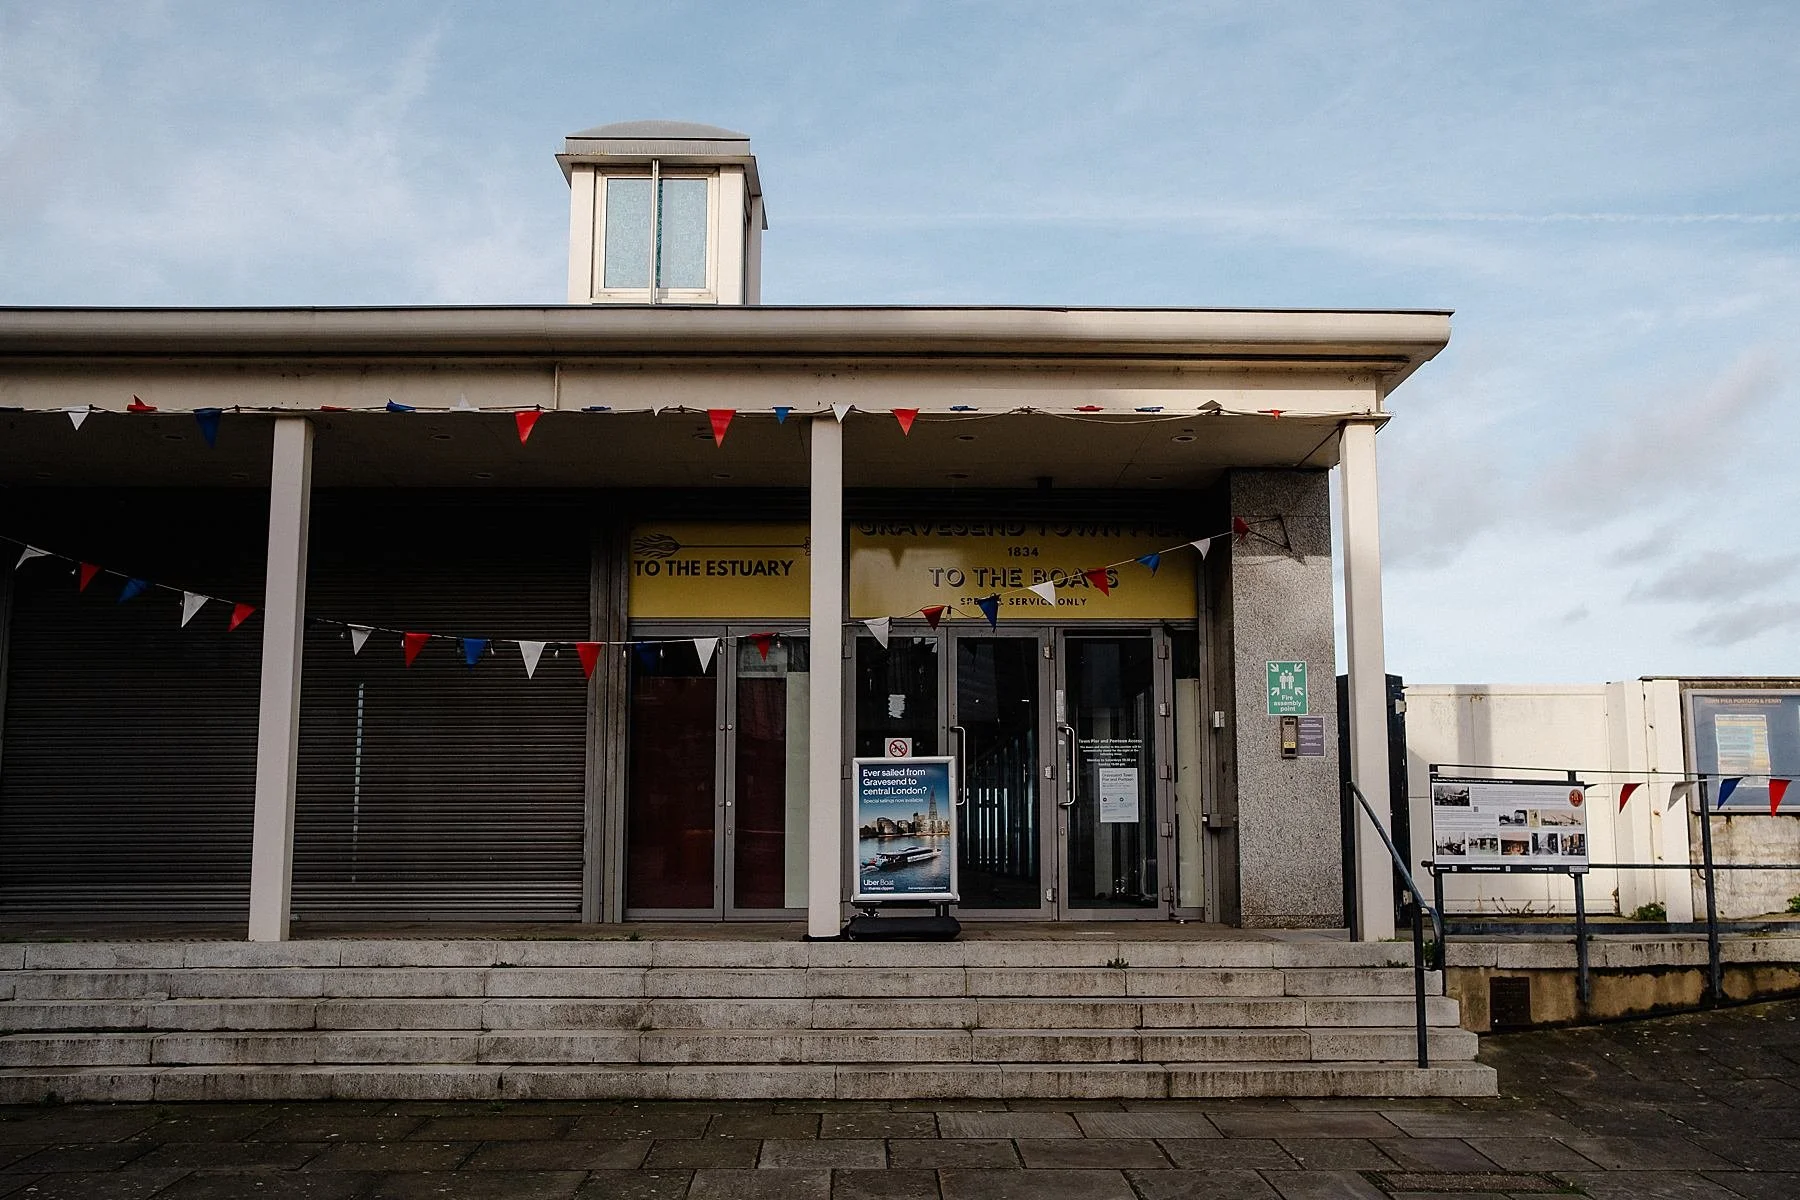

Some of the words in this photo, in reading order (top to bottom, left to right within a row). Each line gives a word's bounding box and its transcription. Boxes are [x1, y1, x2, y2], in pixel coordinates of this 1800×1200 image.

[1007, 547, 1039, 557] 1834
[634, 560, 661, 576] TO
[665, 560, 700, 576] THE
[706, 560, 794, 576] ESTUARY
[928, 567, 966, 588] TO
[973, 567, 1023, 588] THE
[1031, 568, 1120, 588] BOAS
[1057, 597, 1087, 606] ONLY
[863, 769, 880, 777] Ever
[881, 768, 905, 777] sailed
[906, 768, 926, 776] from
[863, 778, 907, 786] Gravesend
[863, 787, 891, 795] central
[891, 786, 927, 795] London?
